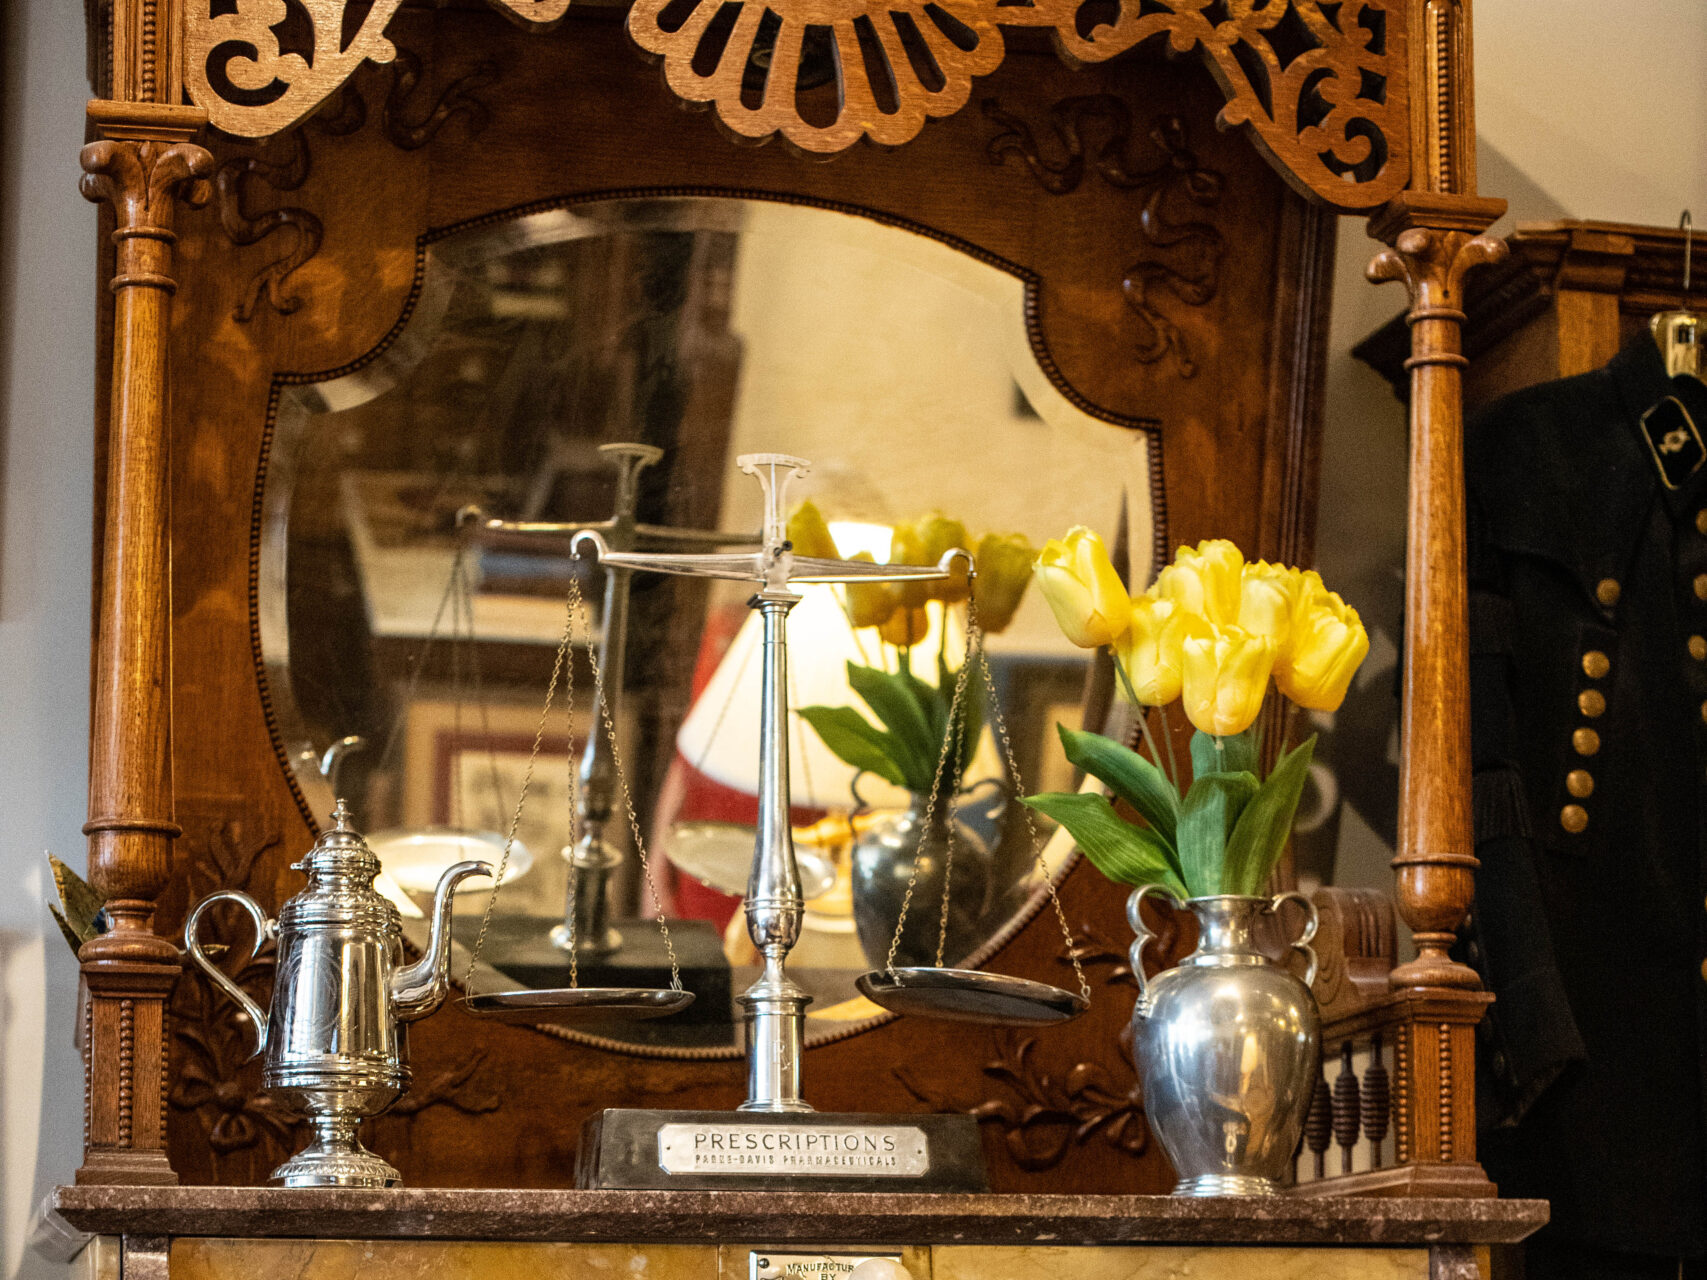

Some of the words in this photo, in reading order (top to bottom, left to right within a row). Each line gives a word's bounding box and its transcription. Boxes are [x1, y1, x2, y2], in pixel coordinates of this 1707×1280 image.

[694, 1133, 895, 1151] PRESCRIPTIONS
[783, 1155, 896, 1166] PHARMACEUTICALS
[787, 1262, 855, 1275] MANUFACTUR
[820, 1273, 837, 1280] BY
